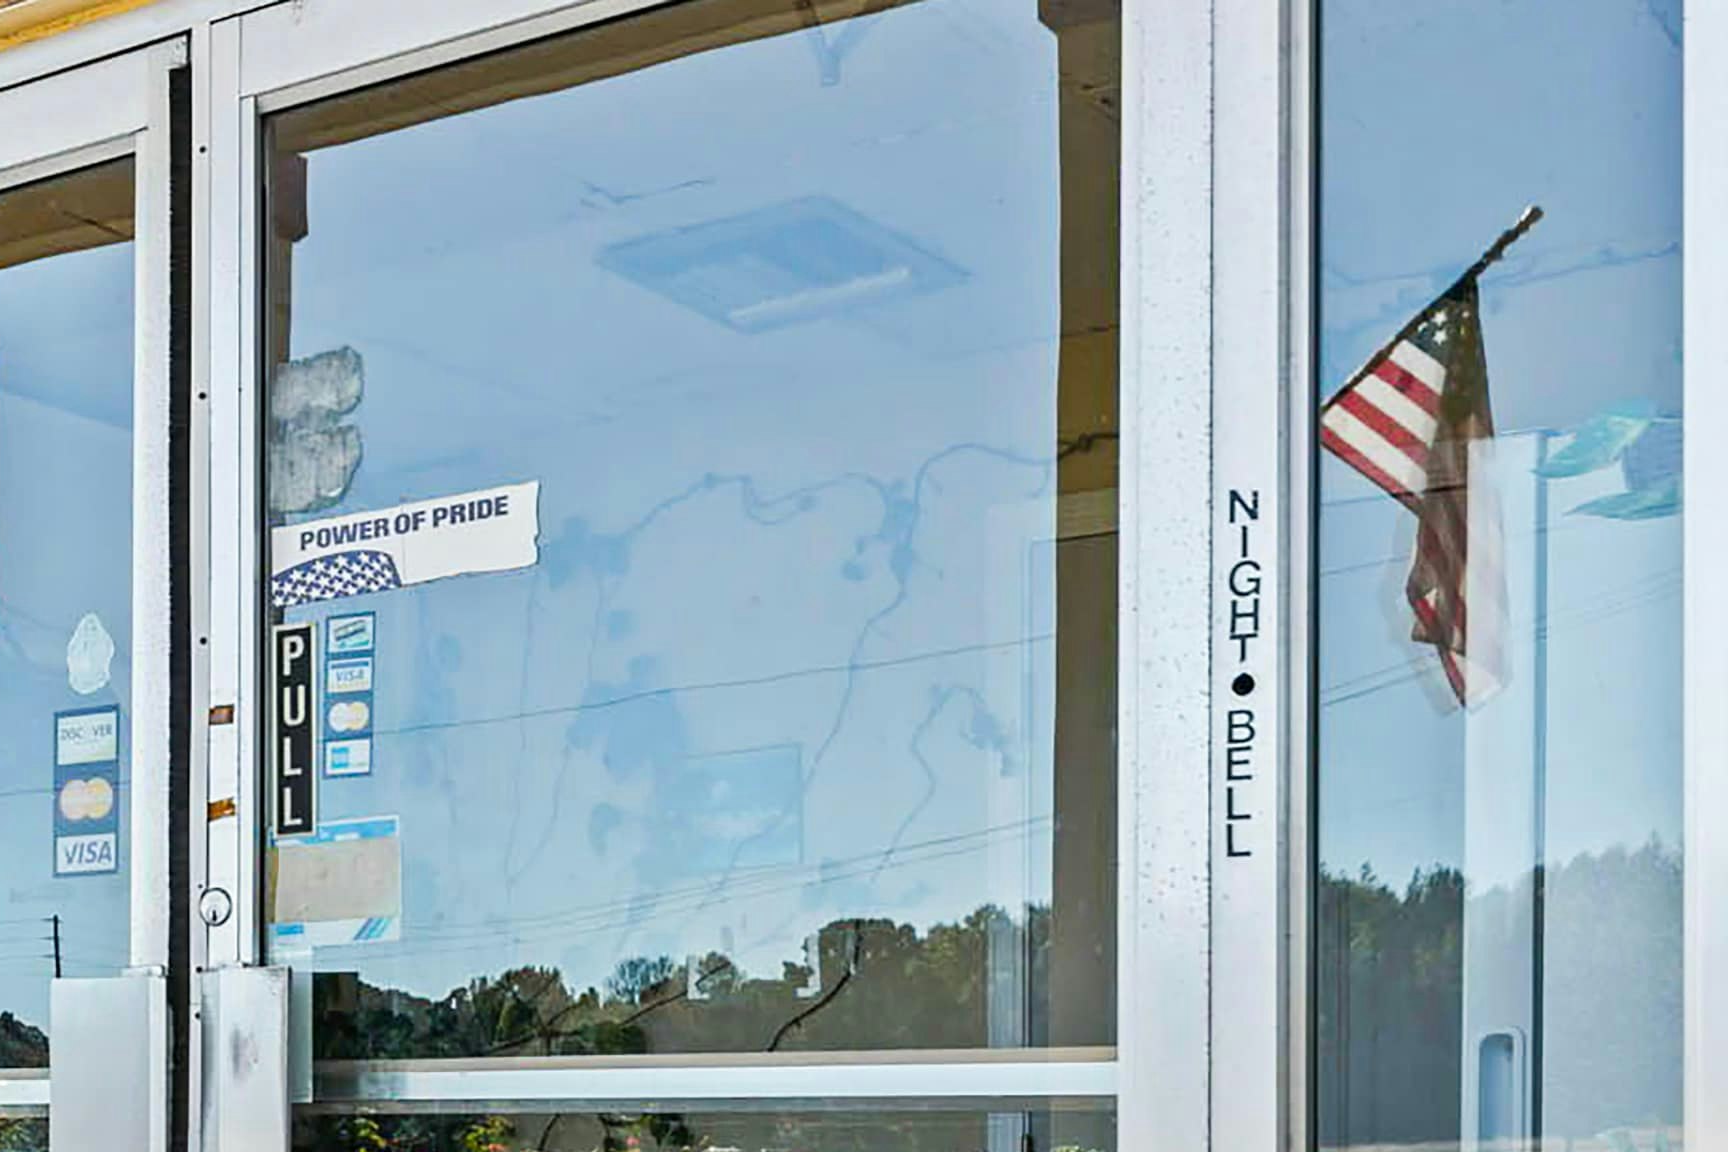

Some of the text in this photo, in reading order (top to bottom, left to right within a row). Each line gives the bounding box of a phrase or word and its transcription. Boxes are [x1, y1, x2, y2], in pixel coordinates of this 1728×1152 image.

[300, 495, 509, 551] POWER OF PRIDE
[1227, 489, 1261, 857] NIGHT BELL
[60, 722, 113, 741] DISCVER
[282, 634, 306, 827] PULL
[65, 841, 113, 865] VISA
